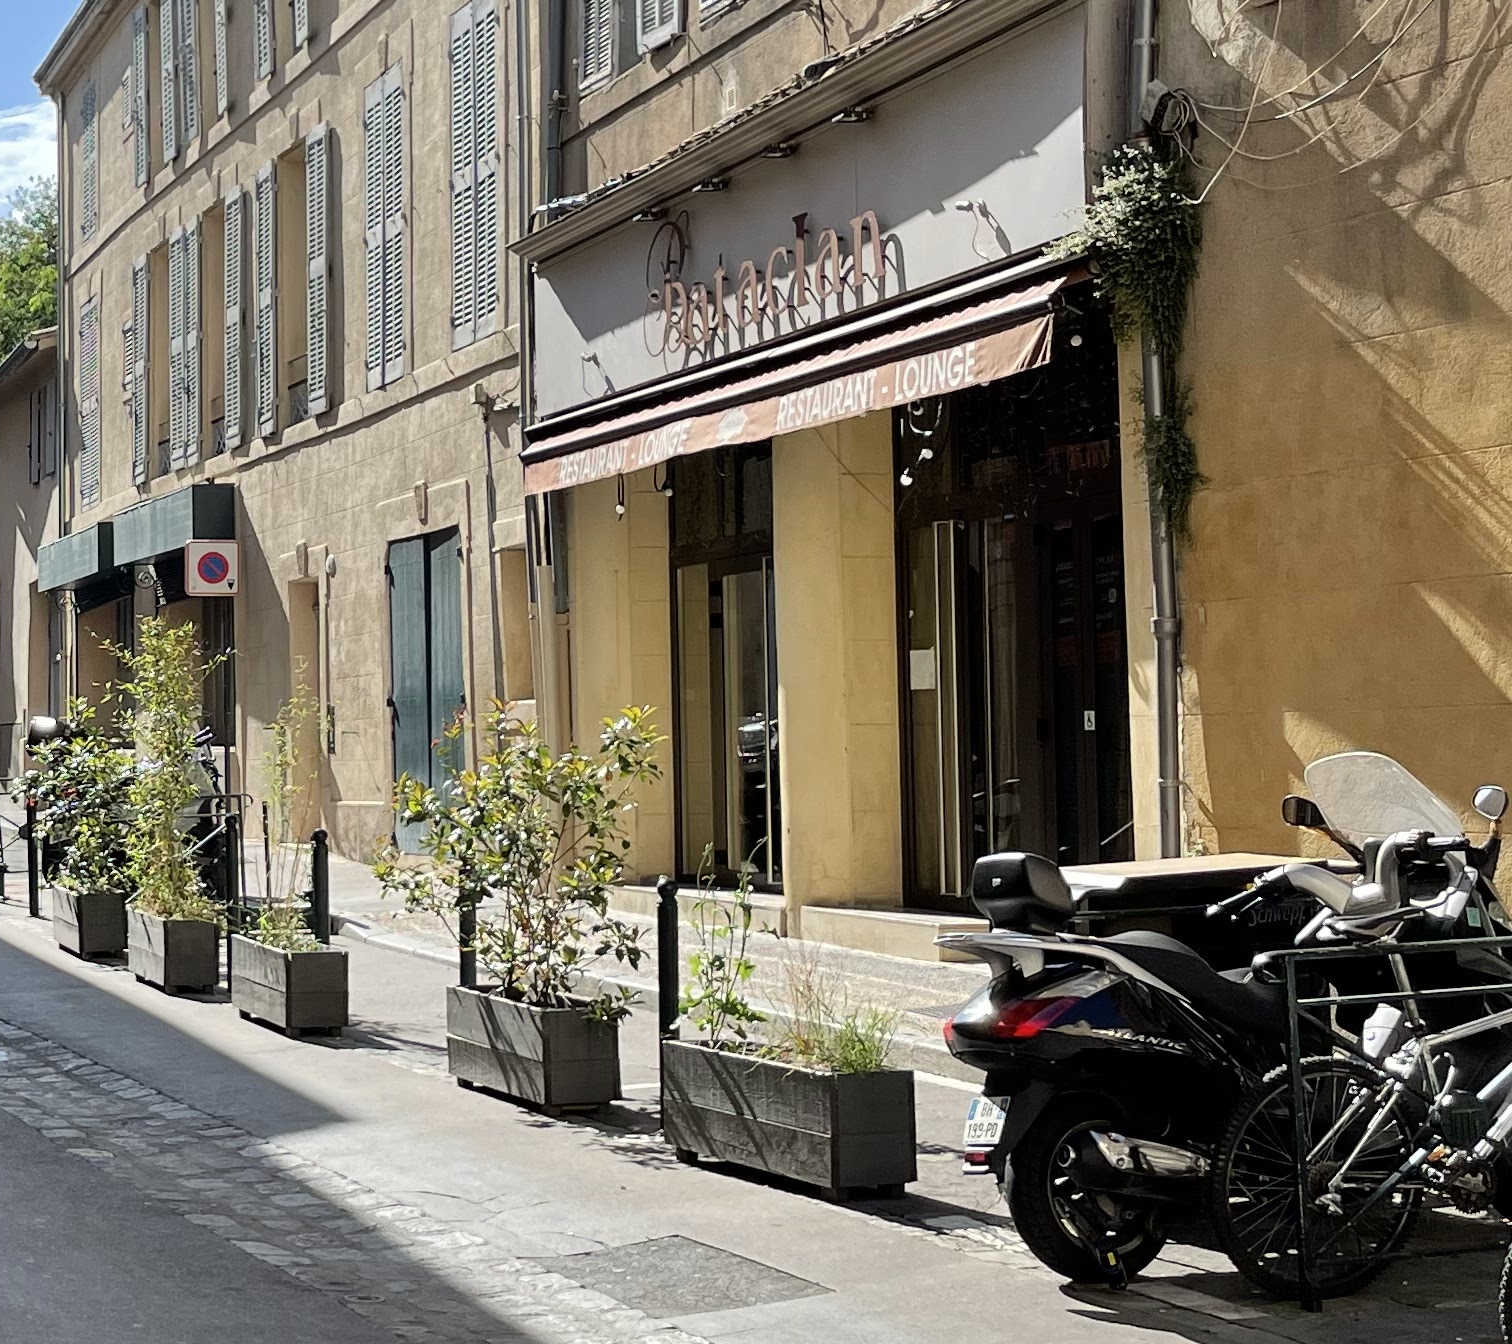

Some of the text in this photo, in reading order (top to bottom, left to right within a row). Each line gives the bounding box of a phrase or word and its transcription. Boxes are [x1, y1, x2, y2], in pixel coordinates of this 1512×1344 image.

[775, 368, 878, 431] RESTAURANT
[894, 342, 977, 401] LOUNGE
[558, 441, 631, 485] RESTAURANT
[637, 419, 692, 466] LOUNGE
